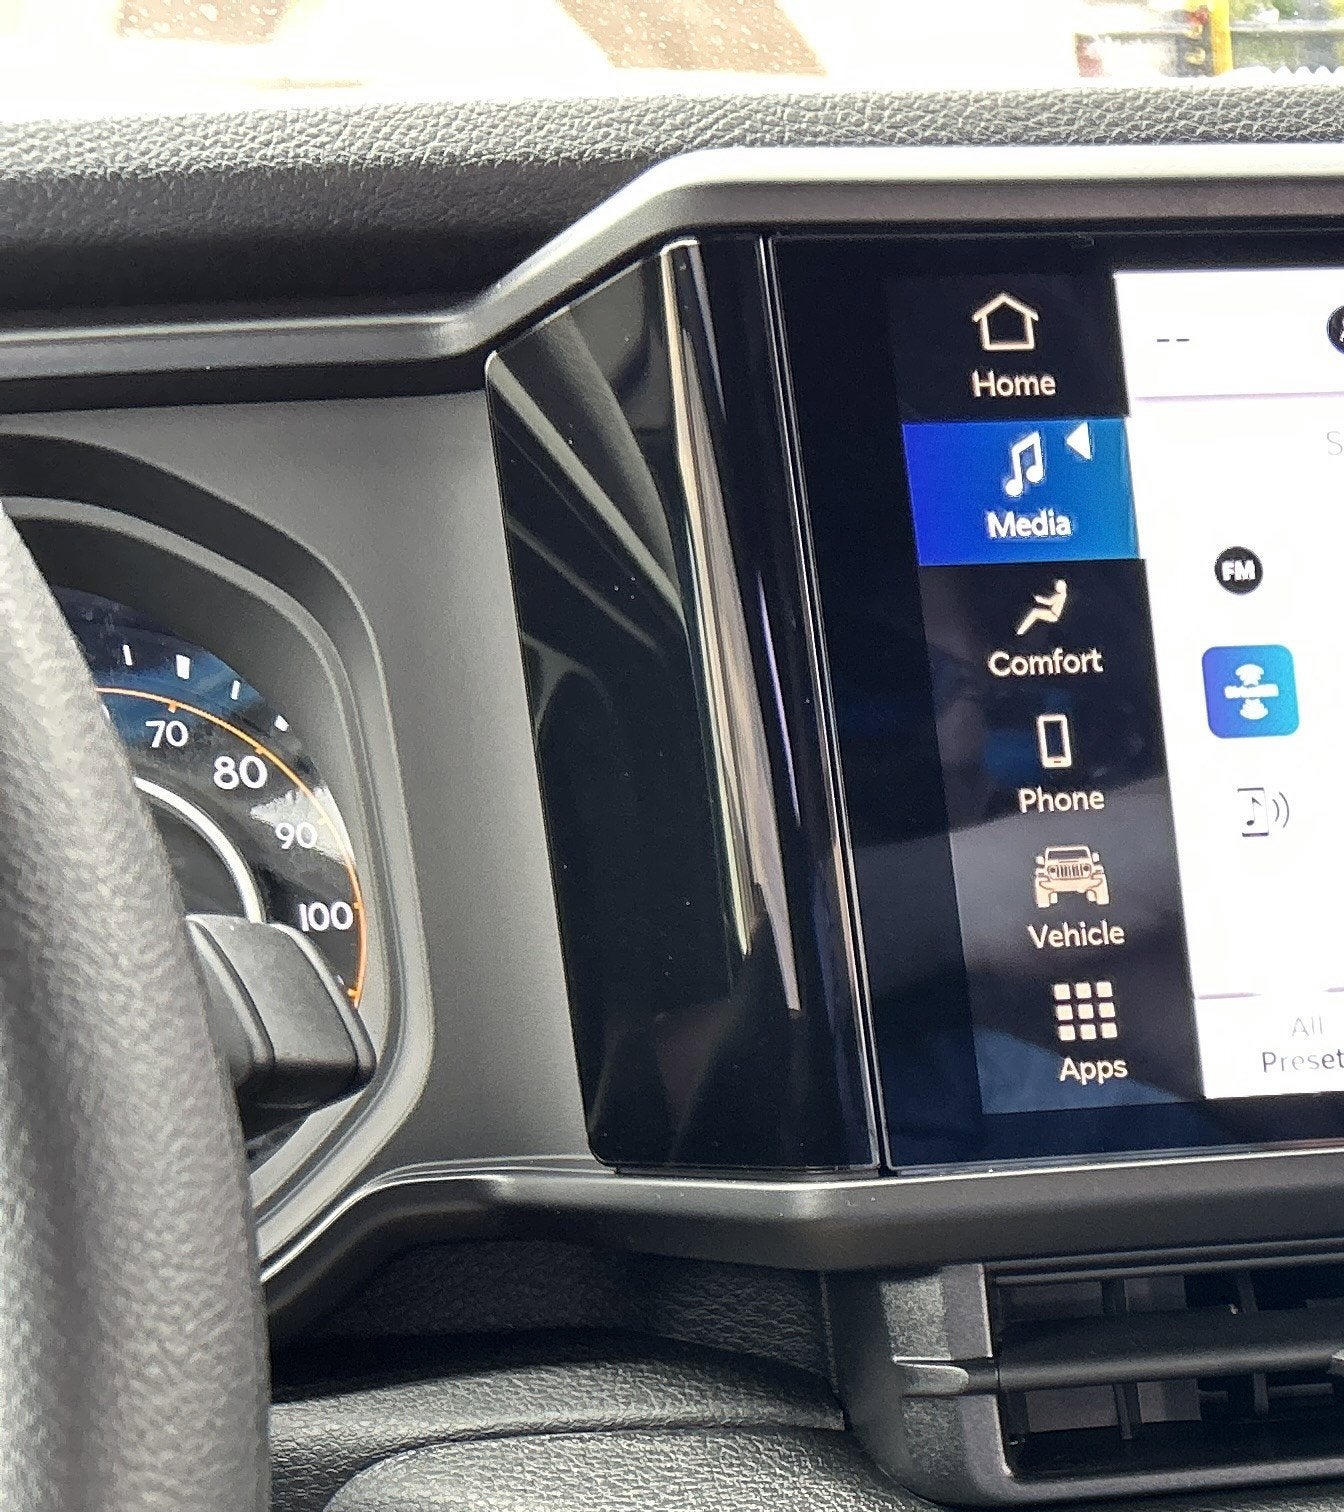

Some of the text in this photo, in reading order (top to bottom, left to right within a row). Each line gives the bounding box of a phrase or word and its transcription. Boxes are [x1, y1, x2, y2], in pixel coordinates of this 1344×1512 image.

[972, 369, 1056, 398] Home
[986, 508, 1072, 539] Media
[1221, 559, 1256, 582] FM
[988, 647, 1104, 677] Comfort
[145, 720, 190, 748] 70
[212, 756, 268, 790] 80
[1019, 785, 1106, 815] Phone
[274, 821, 318, 852] 90
[299, 901, 354, 932] 100
[1028, 919, 1126, 949] Vehicle
[1291, 1016, 1324, 1038] All
[1059, 1056, 1129, 1088] Apps
